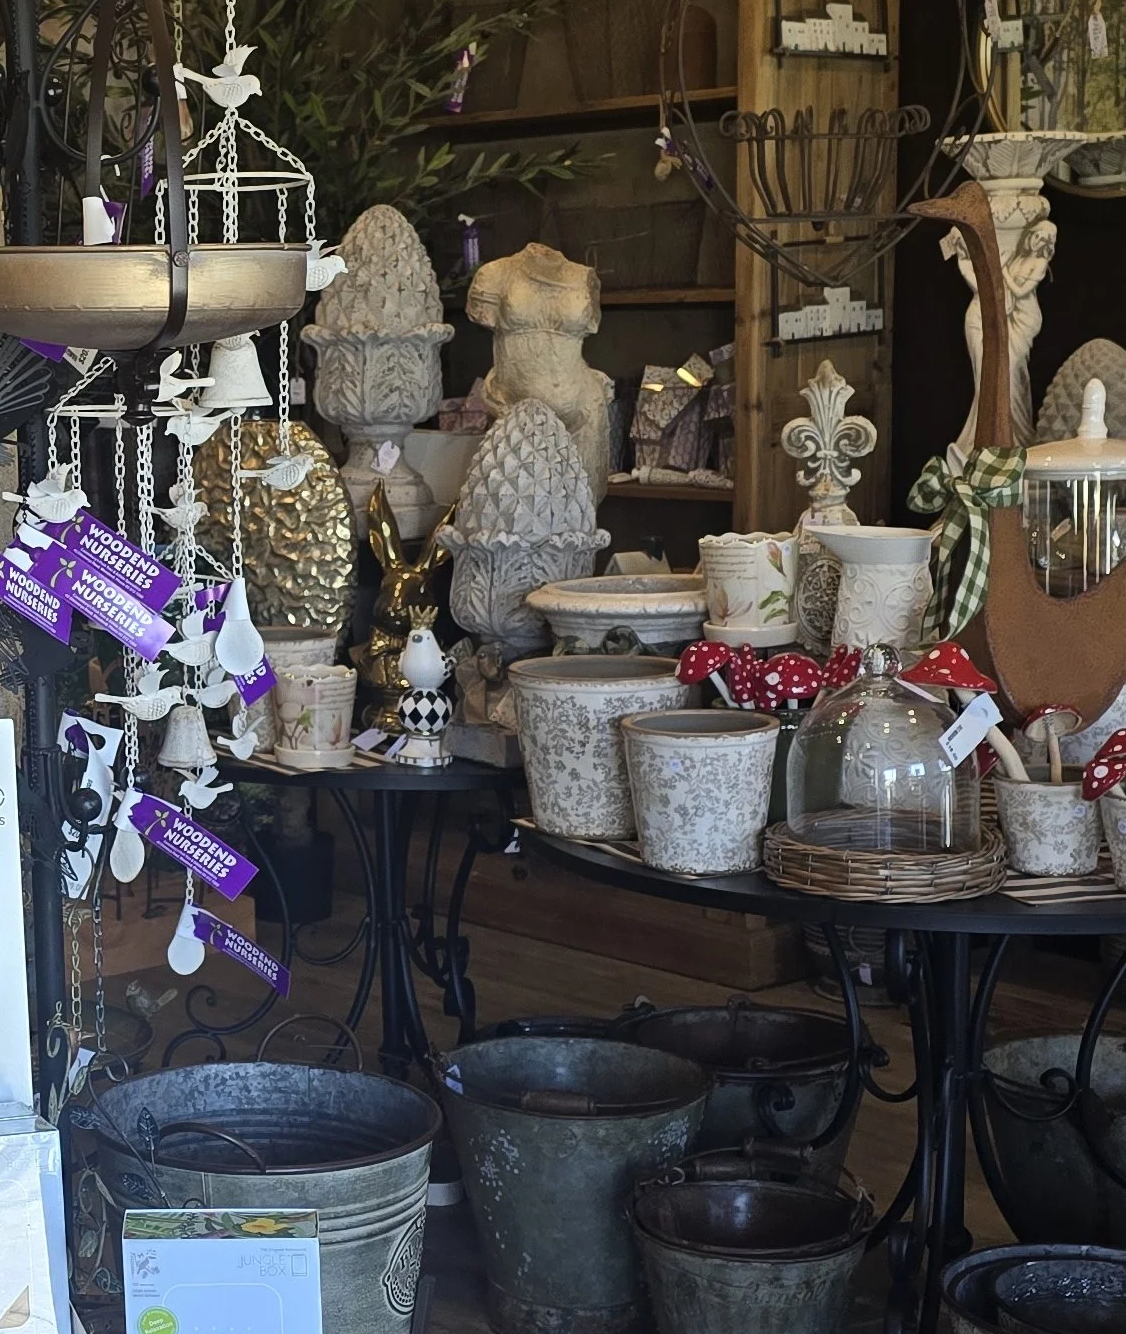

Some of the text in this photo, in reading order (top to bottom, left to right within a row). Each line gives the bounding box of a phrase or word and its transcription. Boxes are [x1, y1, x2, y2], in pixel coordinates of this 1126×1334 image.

[79, 534, 153, 589] NURSERIES
[89, 523, 160, 577] WOODEND
[5, 579, 58, 623] NURSERIES
[9, 566, 61, 610] WOODEND
[71, 580, 146, 638] NURSERIES
[81, 569, 153, 626] WOODEND
[163, 828, 230, 880] NURSERIES
[173, 817, 237, 868] WOODEND
[224, 937, 278, 982] NURSERIES
[226, 929, 279, 973] WOODEND
[238, 1253, 287, 1269] JUNGLE
[259, 1267, 287, 1277] BOX
[148, 1318, 164, 1327] Deep
